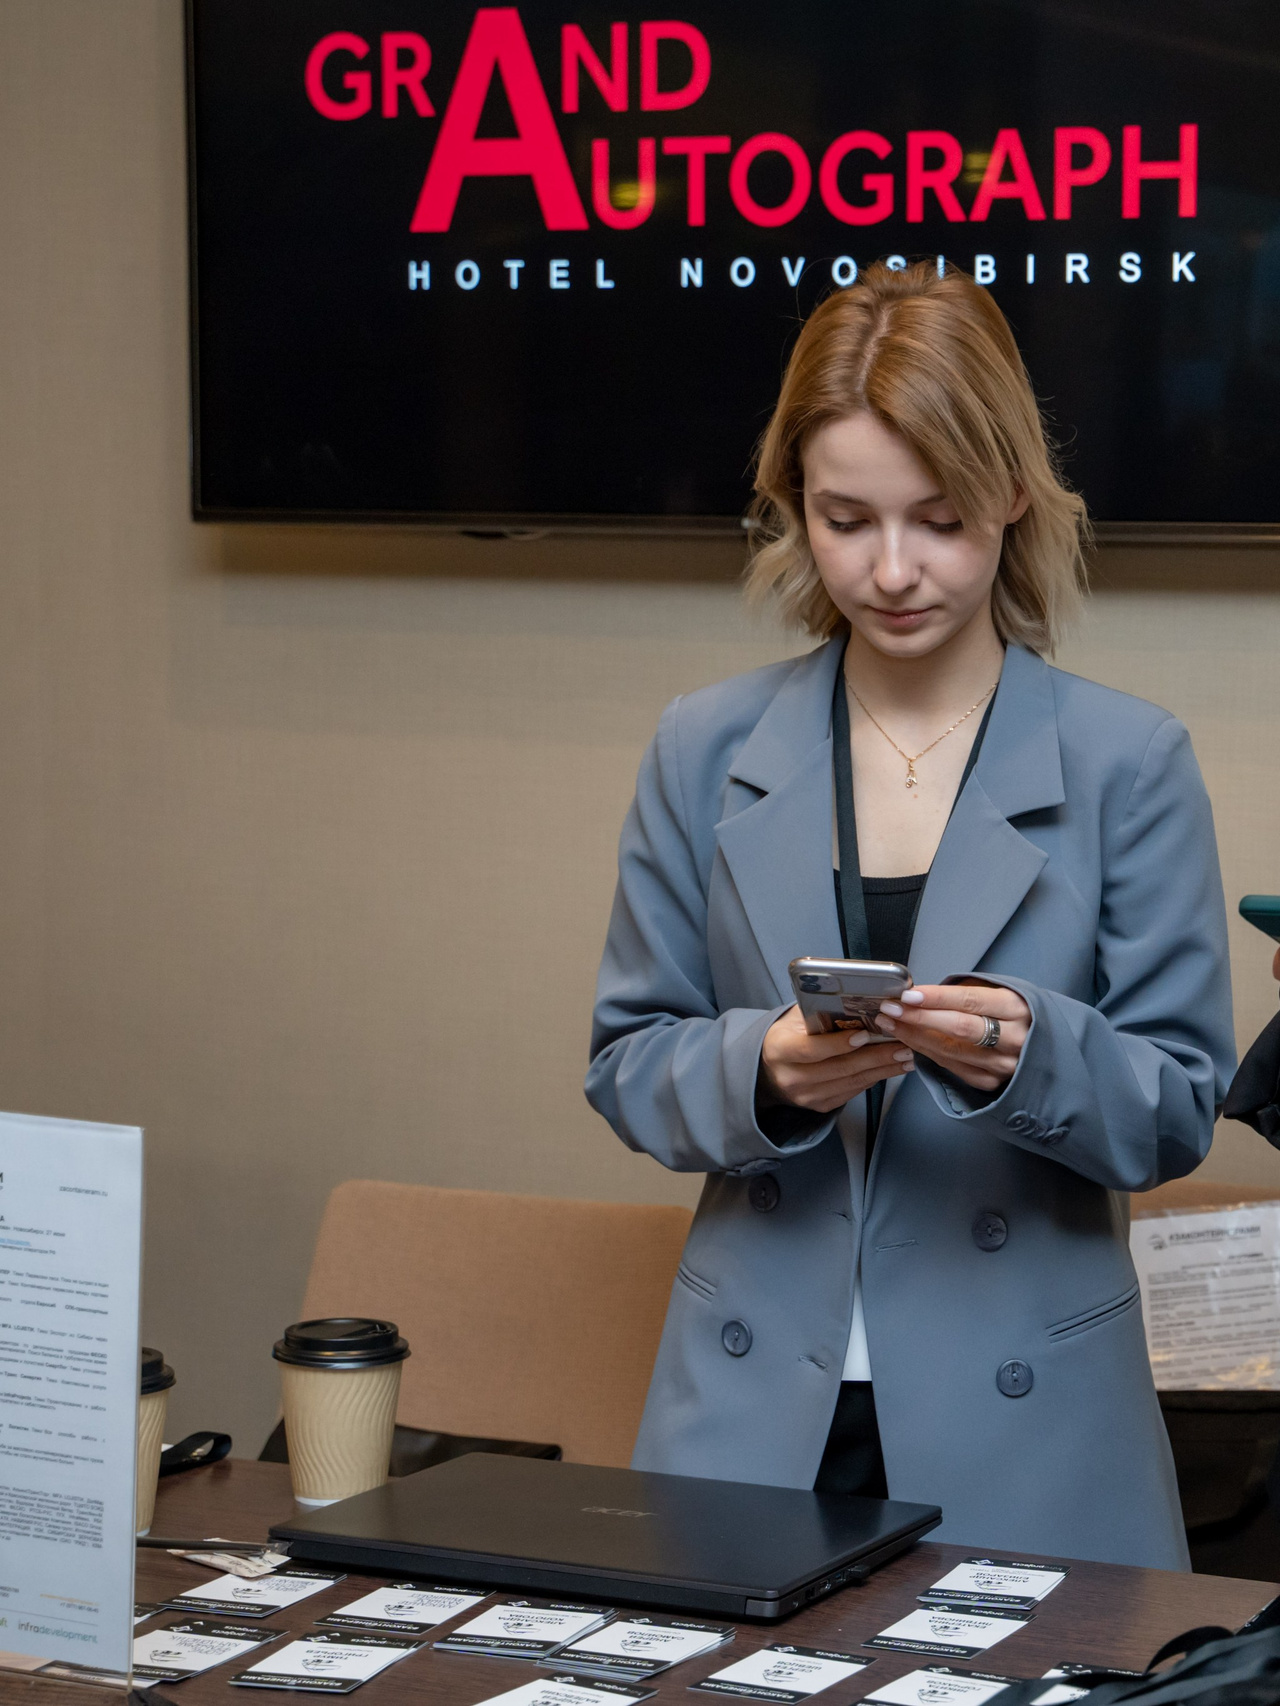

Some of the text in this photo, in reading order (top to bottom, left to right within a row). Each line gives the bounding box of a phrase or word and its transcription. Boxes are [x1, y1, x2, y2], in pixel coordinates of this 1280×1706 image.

[304, 6, 712, 233] GRAND
[408, 258, 615, 291] HOTEL
[580, 1506, 660, 1519] acer
[969, 1575, 1029, 1583] АЛЕКСАНДР
[498, 1617, 565, 1625] АЛЕКСАНДРА
[928, 1619, 987, 1629] ЕКАТЕРИНА
[18, 1620, 98, 1643] infradevelopment
[306, 1650, 369, 1658] ГРИГОРЬЕВ
[773, 1664, 813, 1673] СЕРГЕЙ
[928, 1684, 968, 1693] НИКИТА
